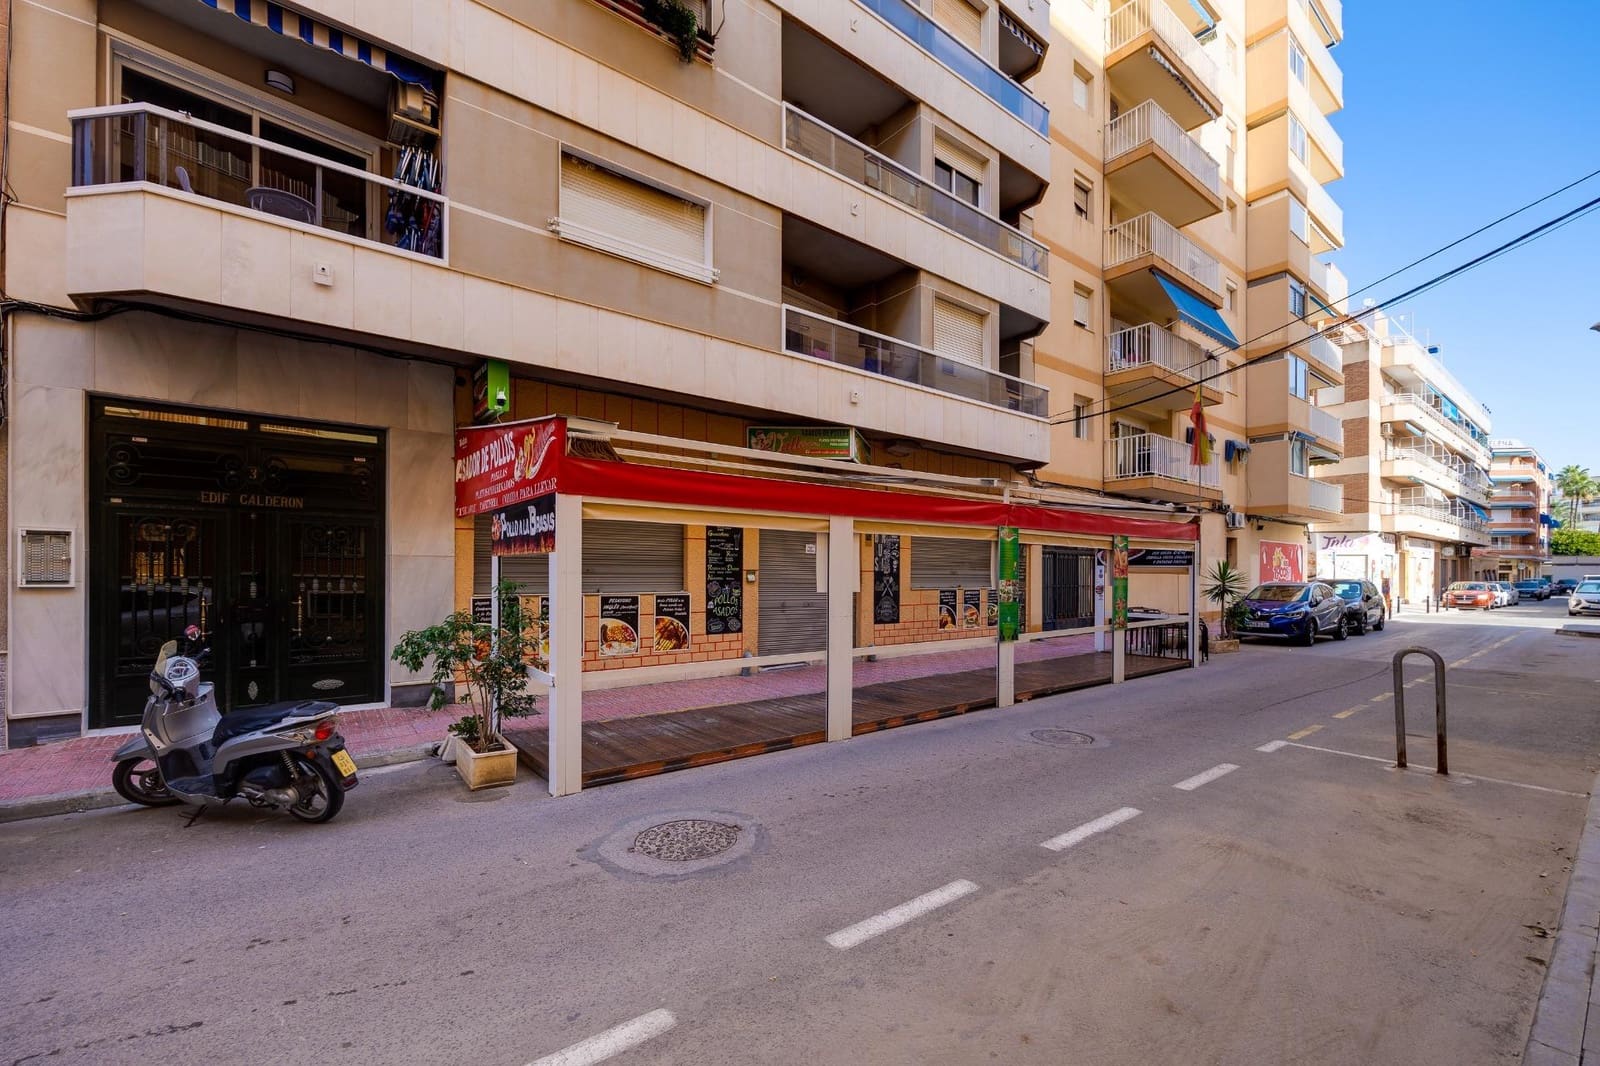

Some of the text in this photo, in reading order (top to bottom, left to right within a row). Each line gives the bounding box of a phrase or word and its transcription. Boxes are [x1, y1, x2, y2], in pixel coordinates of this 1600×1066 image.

[456, 450, 480, 482] ASADOR
[481, 445, 489, 474] DE
[489, 431, 515, 470] POLLOS
[248, 467, 258, 480] 3
[519, 487, 534, 500] PARA
[534, 477, 557, 495] LLEVAR
[200, 490, 304, 509] EDIF CALDERON
[714, 593, 738, 606] POLLOS
[713, 605, 738, 617] ASADOS
